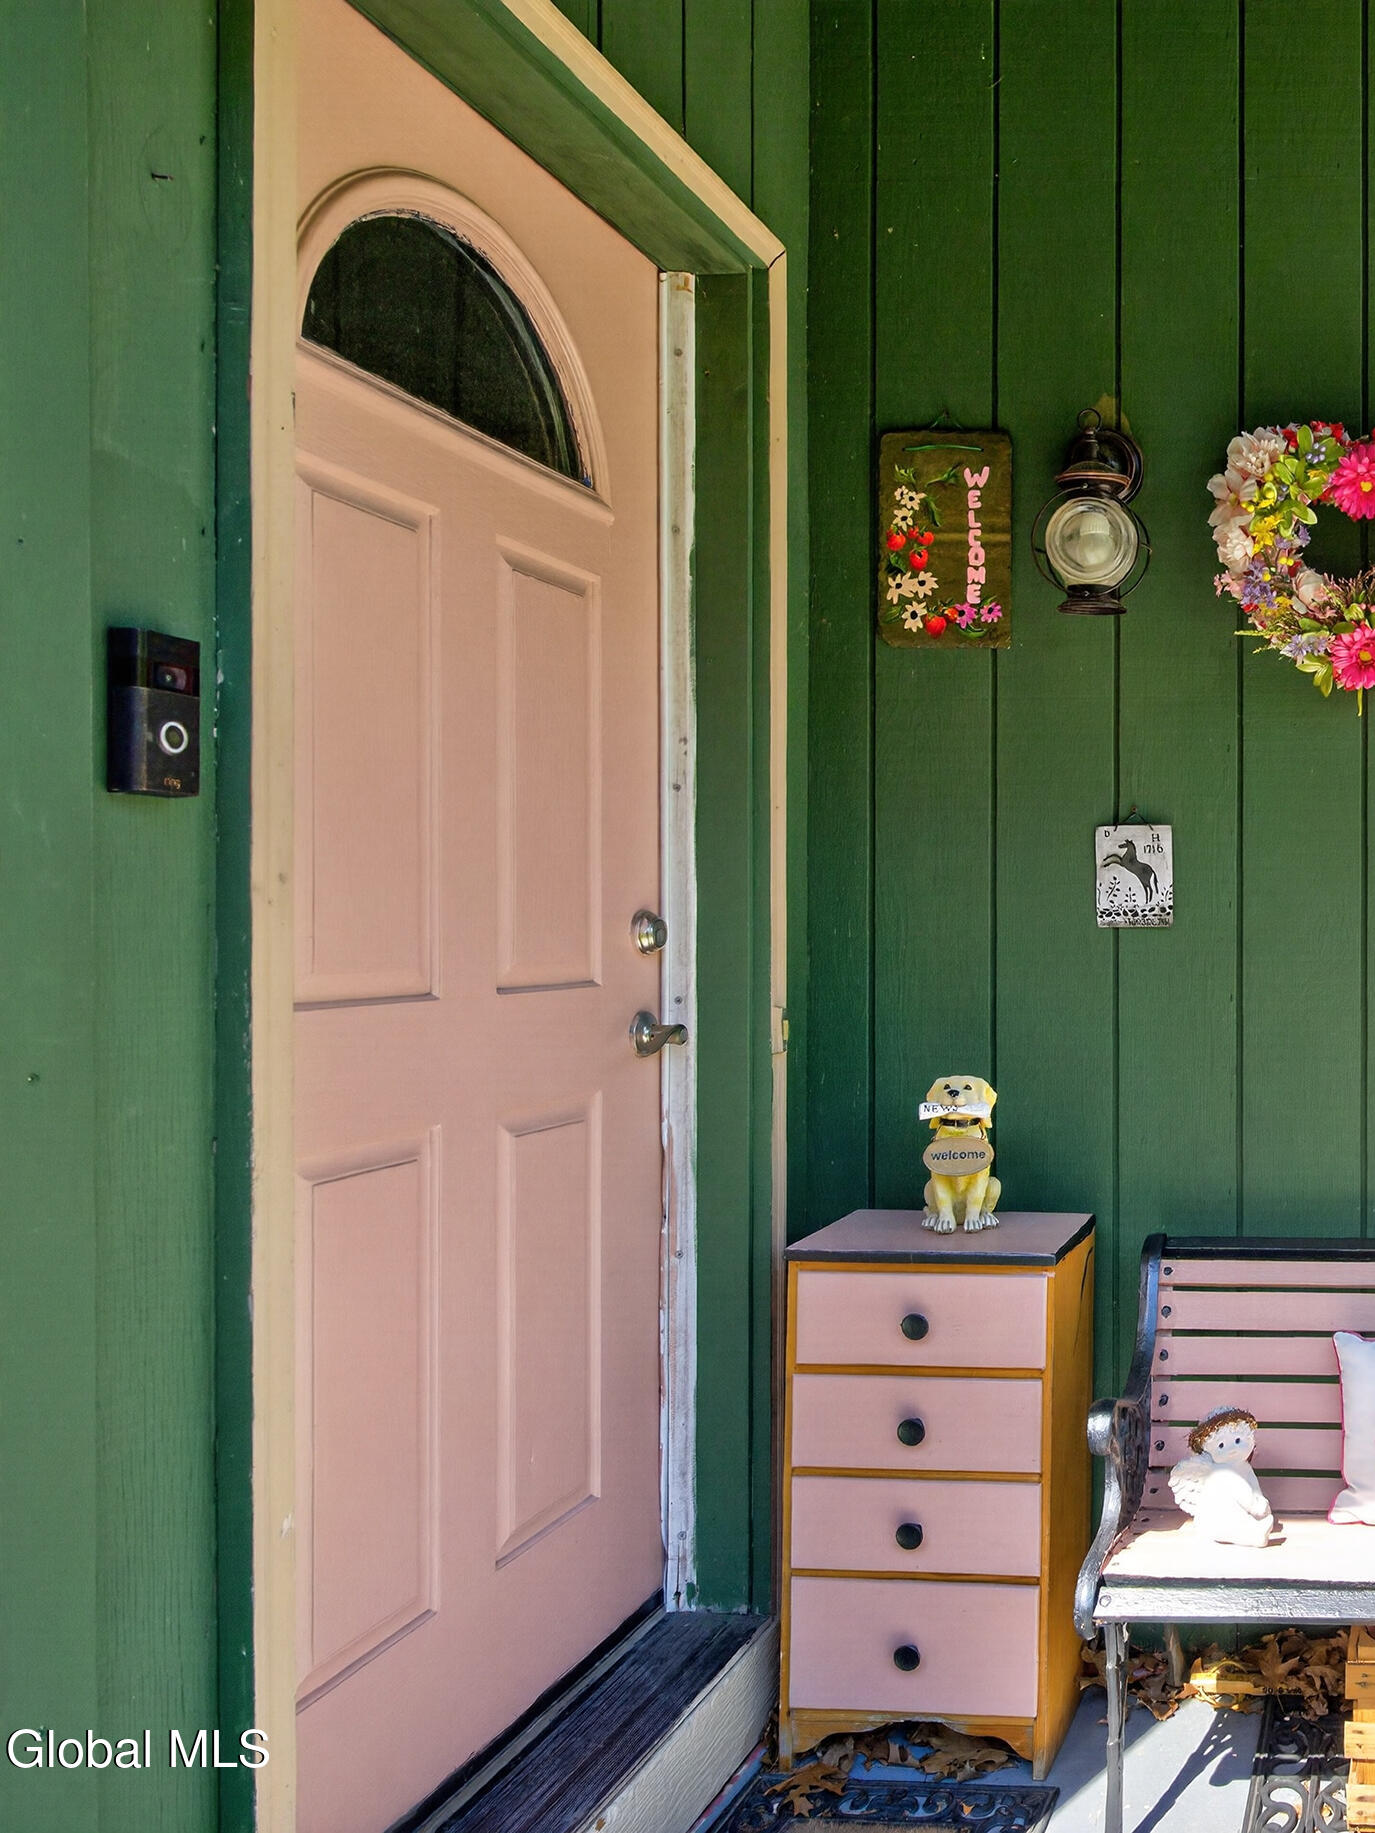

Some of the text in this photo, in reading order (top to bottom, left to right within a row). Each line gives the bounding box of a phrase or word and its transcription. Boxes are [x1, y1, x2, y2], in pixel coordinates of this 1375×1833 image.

[963, 465, 990, 604] WELCOME
[163, 776, 182, 790] ring
[923, 1104, 959, 1113] NEWS
[930, 1149, 986, 1161] welcome
